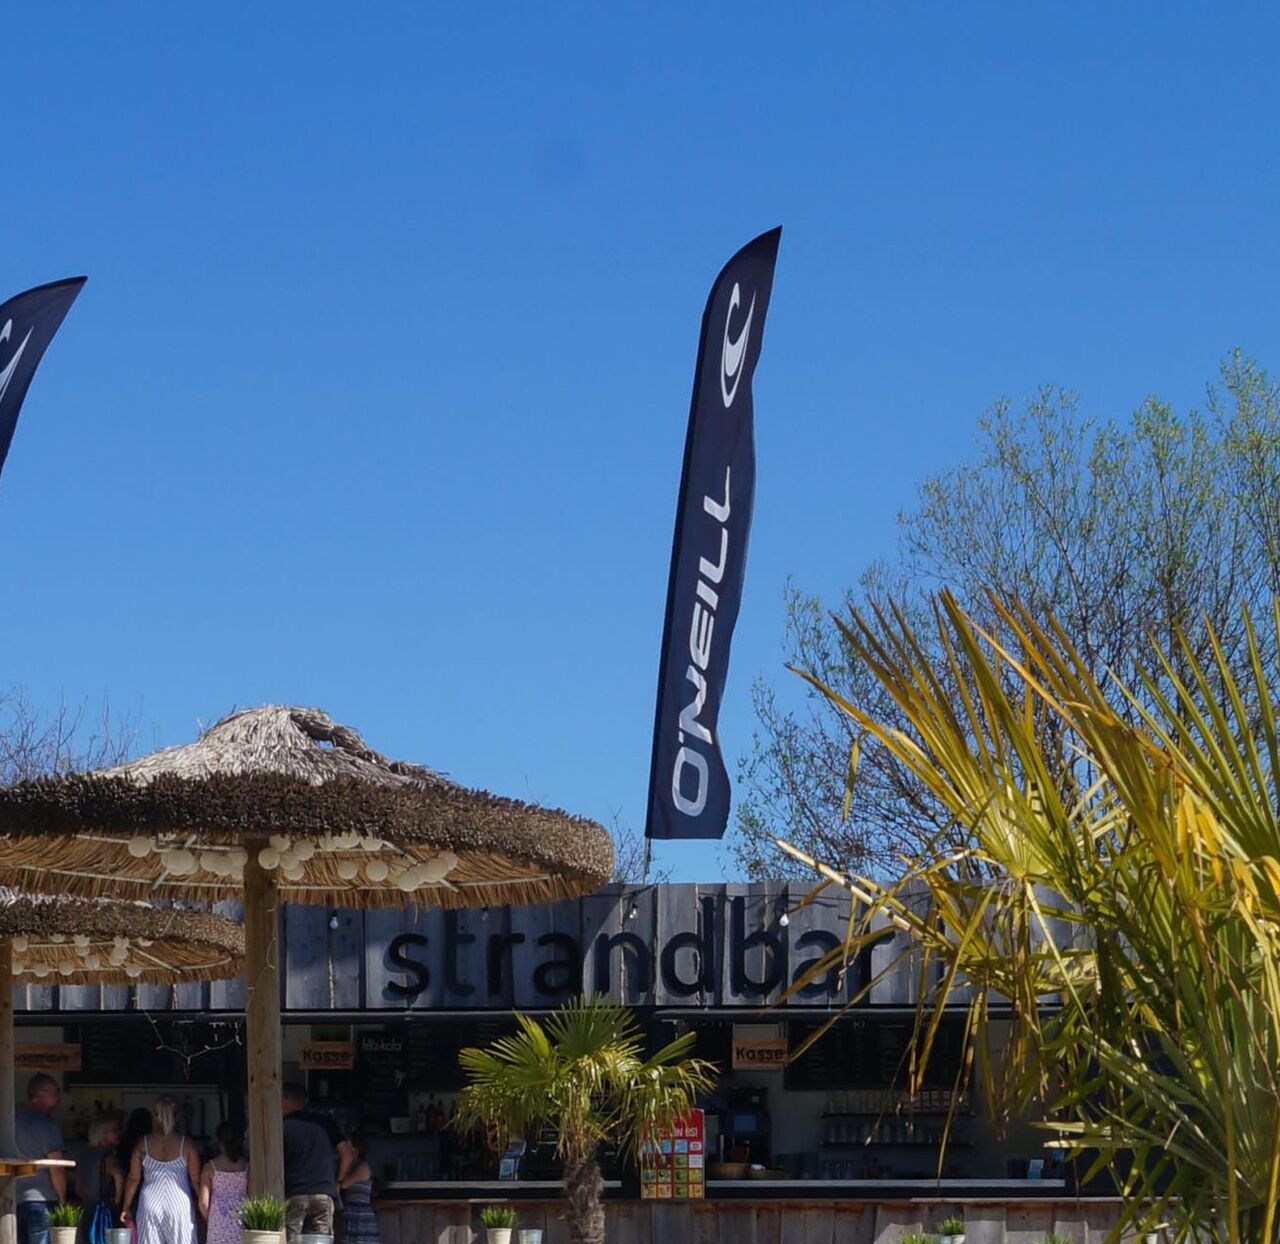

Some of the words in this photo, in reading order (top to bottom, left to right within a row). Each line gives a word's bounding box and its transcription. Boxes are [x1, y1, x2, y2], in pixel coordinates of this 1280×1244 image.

[384, 895, 895, 1000] strandbar
[303, 1049, 349, 1063] Kasse
[736, 1047, 783, 1061] Kasse
